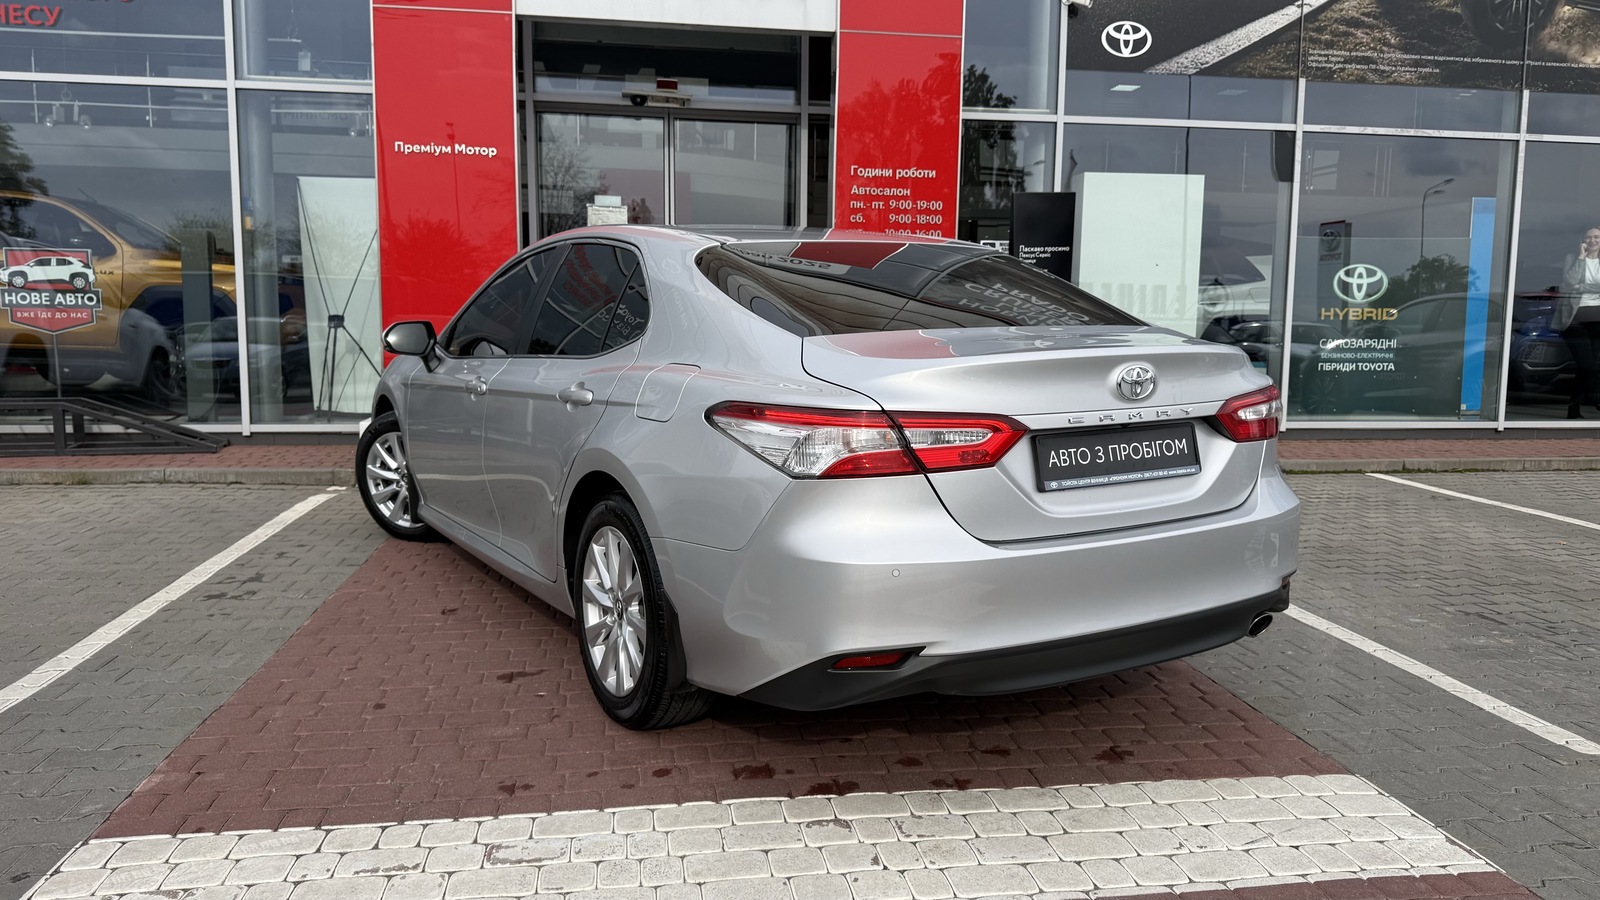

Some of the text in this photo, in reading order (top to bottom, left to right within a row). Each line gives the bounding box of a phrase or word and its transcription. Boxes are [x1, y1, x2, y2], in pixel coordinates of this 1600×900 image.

[394, 141, 497, 158] Преміум Мотор
[850, 165, 936, 180] Години роботи
[850, 185, 911, 196] Автосалон
[889, 200, 943, 210] 9:00-19:00
[850, 213, 943, 224] сб. 9:00-18:00
[4, 292, 97, 305] НОВЕ АВТО
[37, 310, 52, 319] ЇДЕ
[54, 311, 68, 319] ДО
[70, 311, 88, 319] НАС
[1320, 307, 1398, 320] HYBRID
[1318, 362, 1395, 372] ГІБРИДИ TOYOTA
[1068, 407, 1194, 424] CAMRY
[1049, 447, 1091, 468] АВТО
[1108, 438, 1188, 462] ПРОБІГОМ
